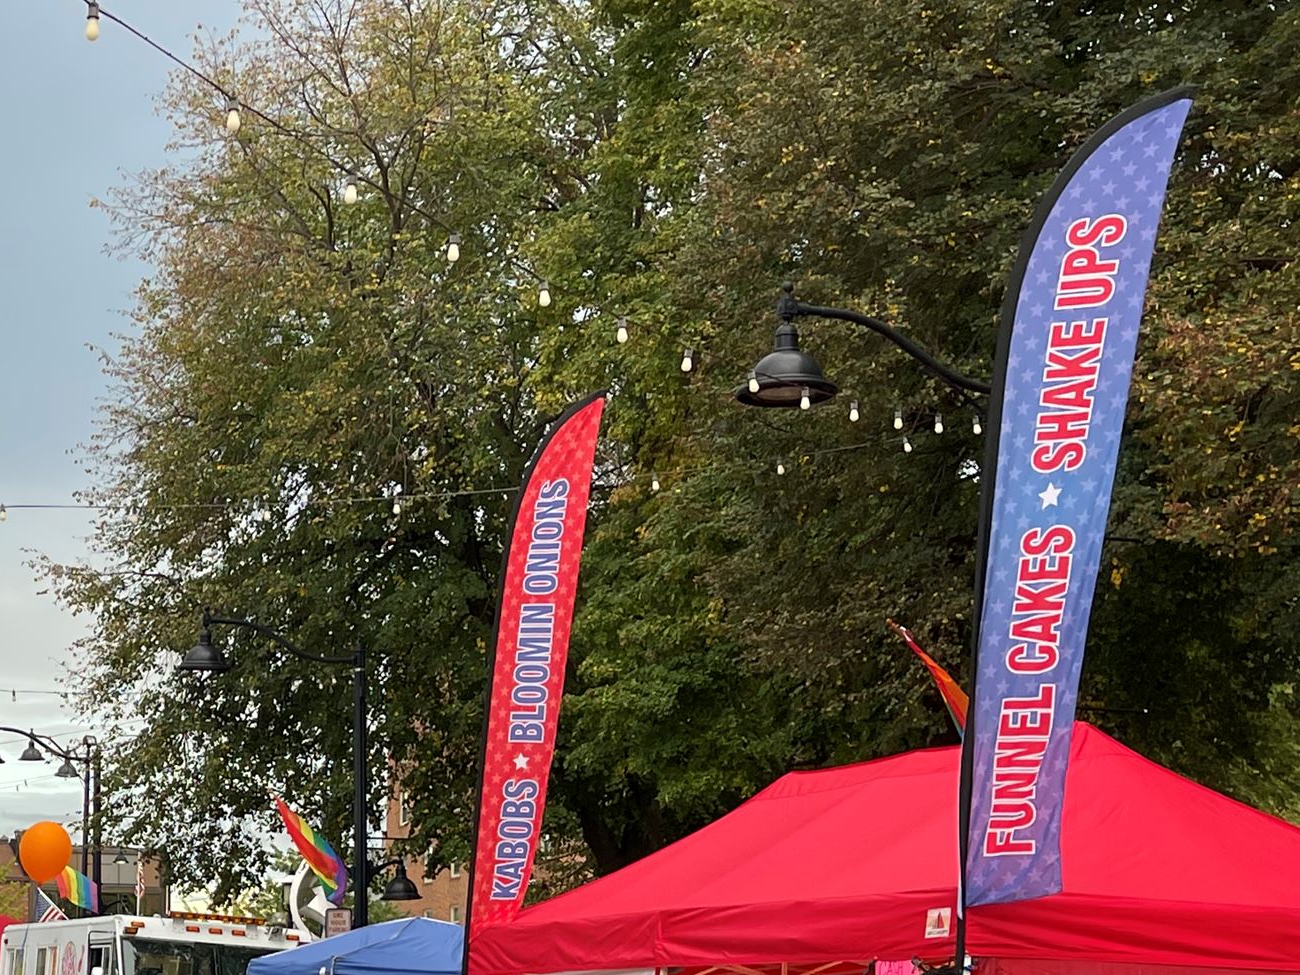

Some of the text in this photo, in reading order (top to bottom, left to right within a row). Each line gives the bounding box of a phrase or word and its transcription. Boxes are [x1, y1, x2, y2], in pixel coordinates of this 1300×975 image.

[490, 478, 570, 901] KABOBS BLOOMIN ONIONS
[984, 214, 1127, 857] FUNNEL CAKES SHAKE UPS
